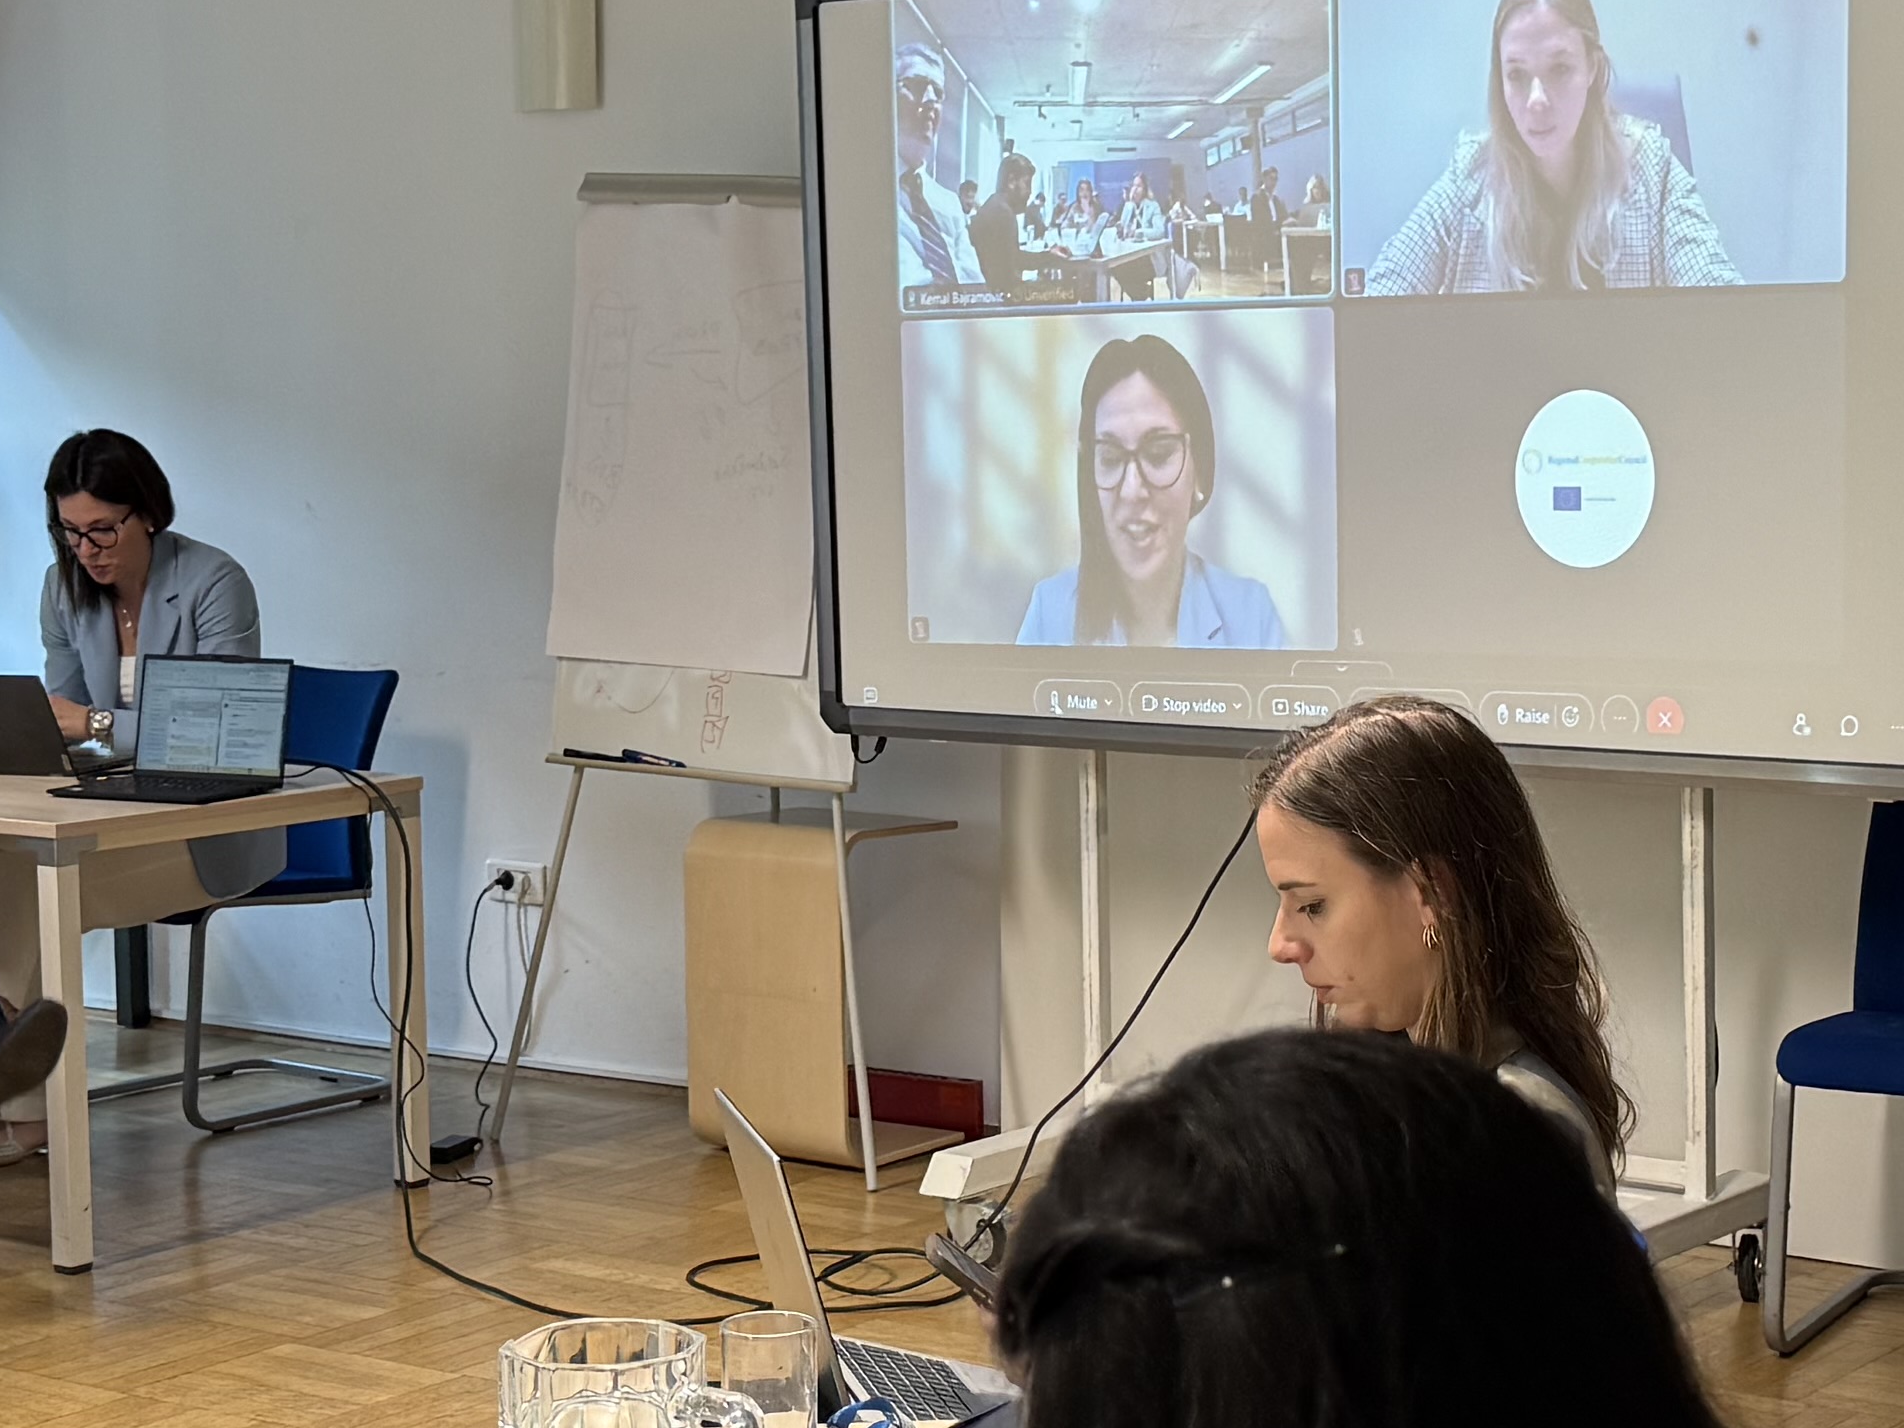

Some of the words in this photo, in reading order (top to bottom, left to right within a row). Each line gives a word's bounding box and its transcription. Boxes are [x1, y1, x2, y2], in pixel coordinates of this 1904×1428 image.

[1067, 695, 1097, 710] Mute
[1163, 697, 1191, 715] Stop
[1192, 698, 1227, 713] video
[1293, 700, 1329, 716] Share
[1515, 708, 1550, 724] Raise
